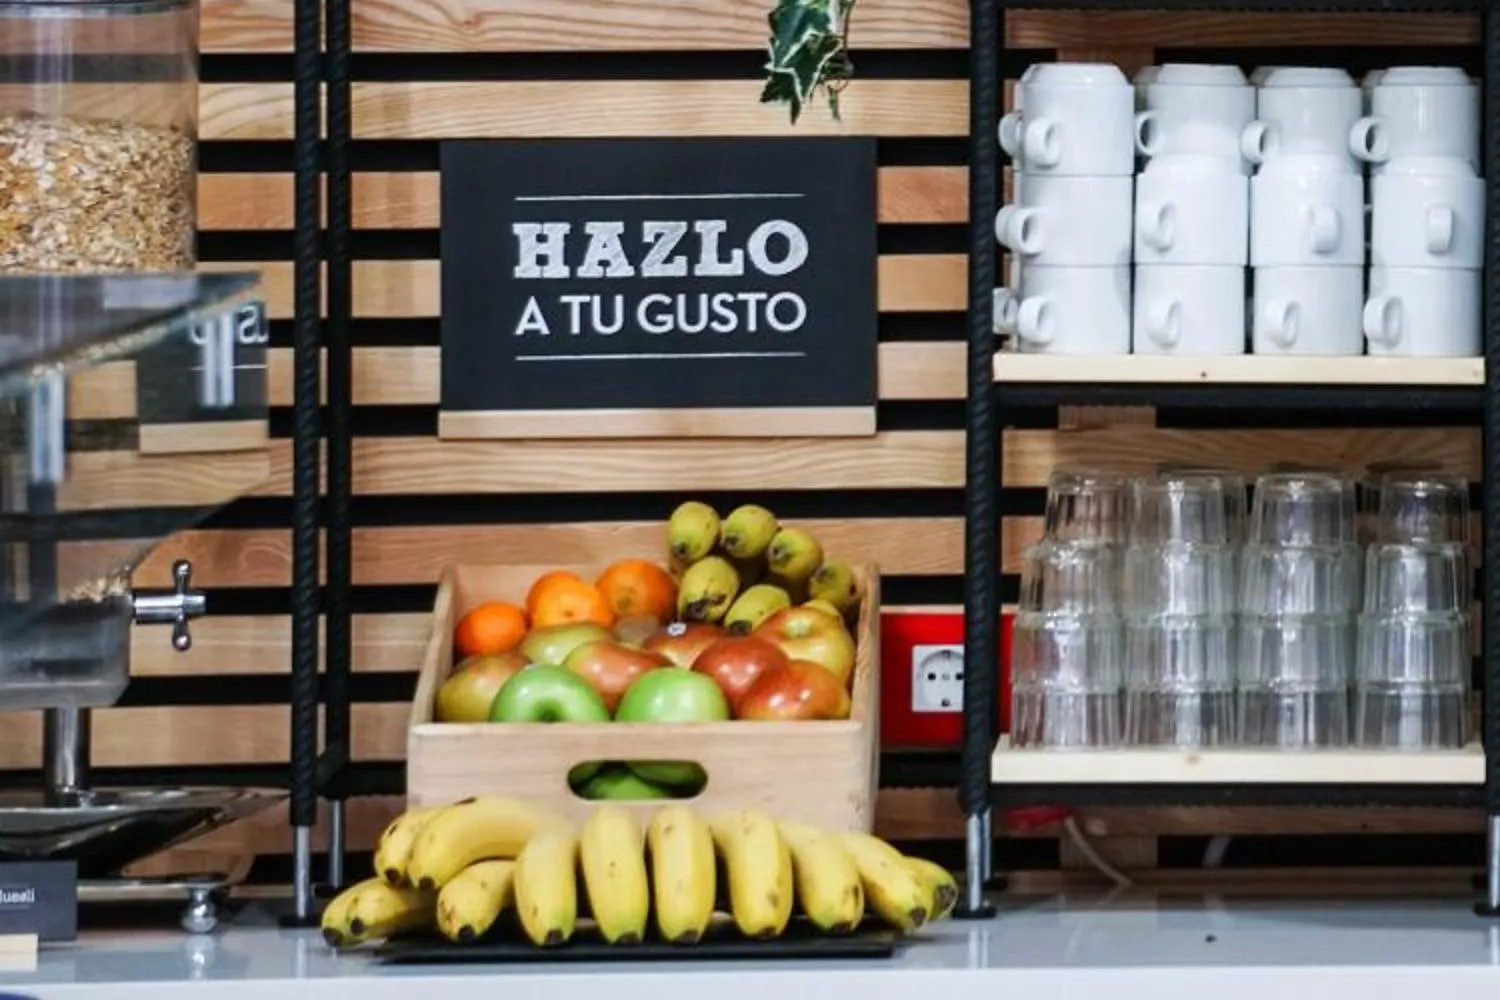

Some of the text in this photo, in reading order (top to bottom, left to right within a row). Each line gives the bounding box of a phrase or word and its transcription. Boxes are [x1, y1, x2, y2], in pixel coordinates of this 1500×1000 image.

[511, 219, 809, 279] HAZLO
[514, 291, 807, 336] A TU GUSTO
